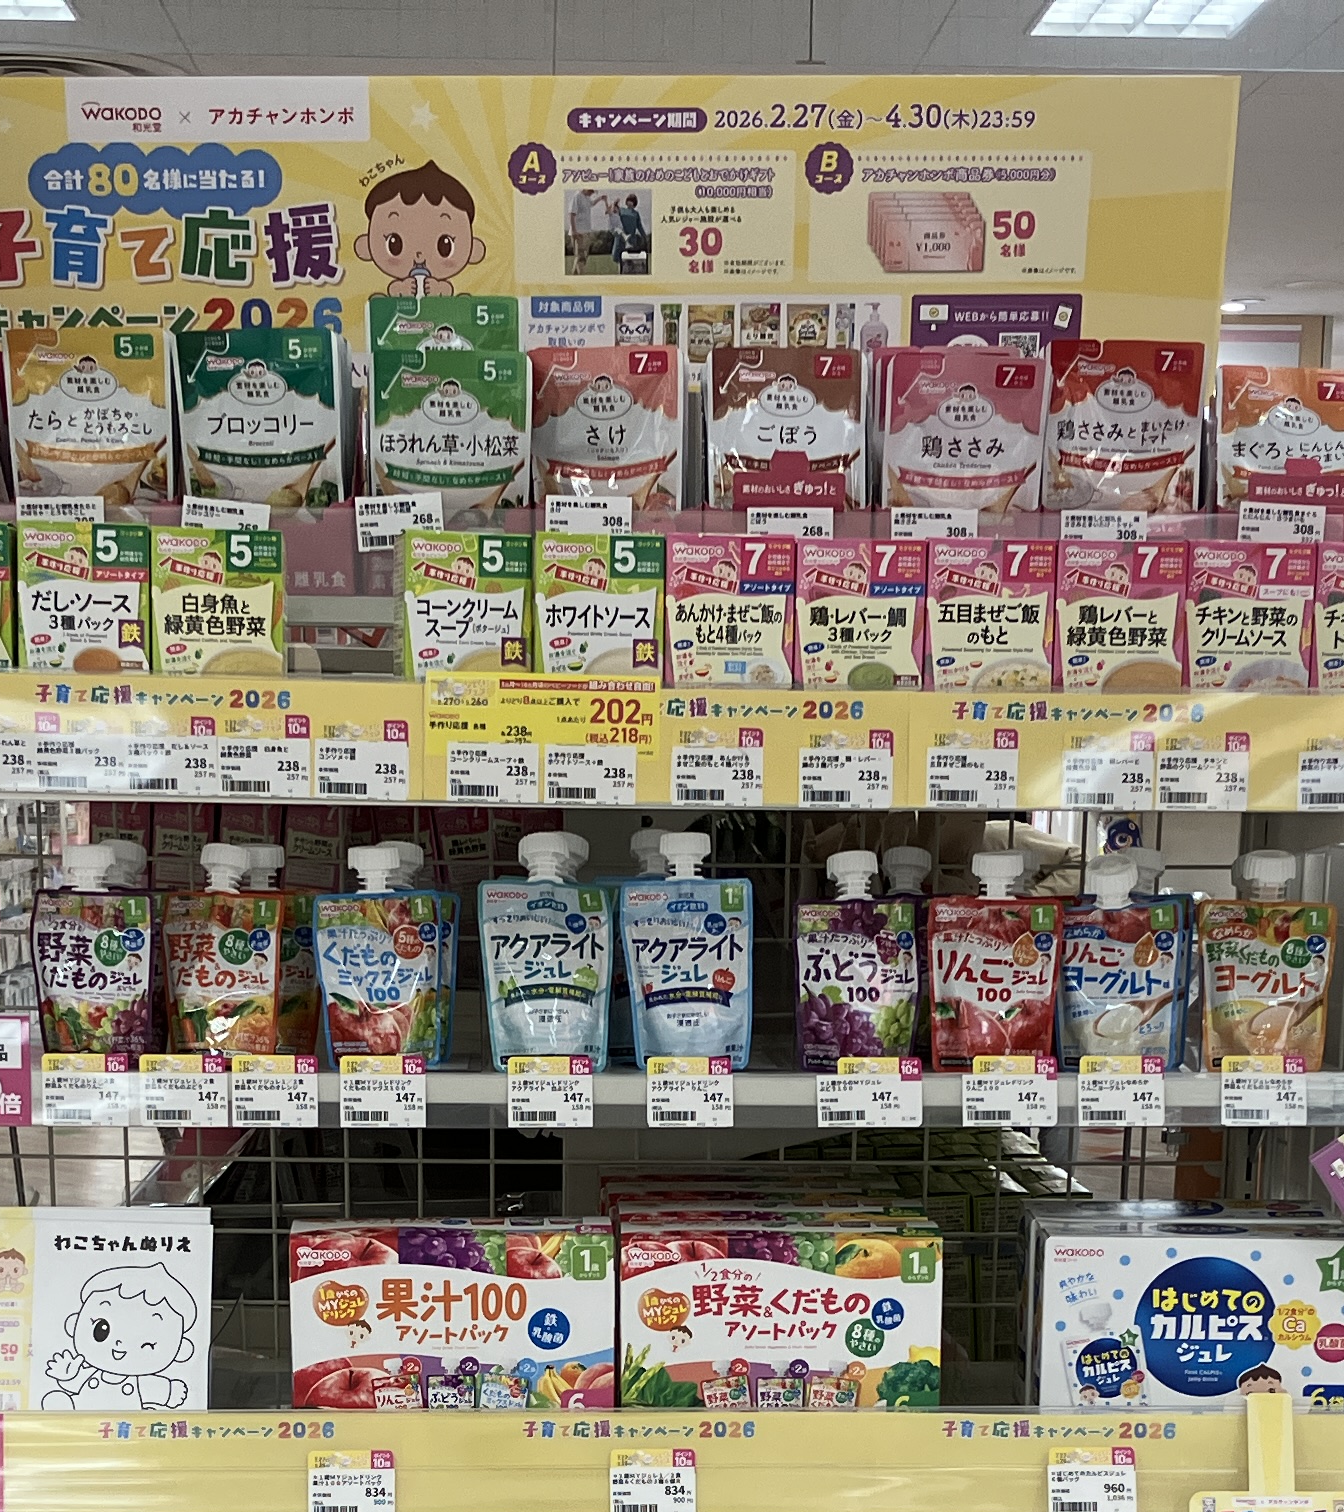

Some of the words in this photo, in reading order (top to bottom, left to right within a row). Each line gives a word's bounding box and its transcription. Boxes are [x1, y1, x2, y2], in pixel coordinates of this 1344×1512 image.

[208, 105, 355, 126] アカチャンホンポ
[578, 112, 697, 129] キャンペーン期間
[523, 151, 540, 173] A
[821, 150, 838, 172] B
[815, 173, 842, 184] コース
[992, 210, 1036, 240] 50
[679, 226, 723, 257] 30
[1000, 243, 1026, 258] 名様
[538, 298, 595, 314] 対象商品例
[28, 409, 77, 431] たらと
[207, 413, 314, 436] ブロッコリー
[380, 434, 519, 458] ほうれん草・小松菜
[586, 424, 627, 446] さけ
[757, 425, 818, 446] ごぼう
[921, 434, 1005, 458] 鶏ささみ
[1232, 440, 1294, 459] まぐろと
[745, 543, 766, 575] 7
[31, 591, 132, 613] だし・ソース
[181, 593, 251, 615] 白身魚と
[416, 598, 518, 620] コーンクリーム
[545, 605, 651, 629] ホワイトソース
[809, 606, 907, 628] 鶏・レバー・鯛
[938, 604, 1040, 624] 五目まぜご飯
[1078, 606, 1158, 624] 鶏レバーと
[1195, 607, 1298, 626] チキンと野菜の
[121, 622, 141, 643] 鉄
[164, 615, 267, 637] 緑黄色野菜
[694, 624, 763, 645] もと4種パック
[967, 626, 1009, 645] のもと
[1201, 629, 1288, 648] クリームソース
[38, 931, 93, 964] 野菜
[323, 941, 396, 966] くだもの
[491, 934, 604, 959] アクアライト
[633, 935, 744, 962] アクアライト
[337, 966, 433, 986] ミックスジュレ
[523, 959, 572, 980] ジュレ
[660, 962, 708, 984] ジュレ
[804, 949, 879, 983] ぶどう
[937, 951, 1012, 985] りんご
[1062, 969, 1161, 995] ヨーグルト
[366, 986, 400, 1002] 100
[54, 1236, 192, 1254] わこちゃんぬりえ
[376, 1278, 528, 1322] 果汁100
[692, 1284, 871, 1318] 野菜&くだもの
[1152, 1288, 1265, 1313] はじめての
[396, 1325, 509, 1345] アソートパック
[724, 1320, 838, 1341] アソートパック
[1150, 1315, 1266, 1342] カルピス
[1282, 1317, 1306, 1333] Ca
[1276, 1333, 1312, 1343] カルシウム
[1104, 1483, 1125, 1495] 960
